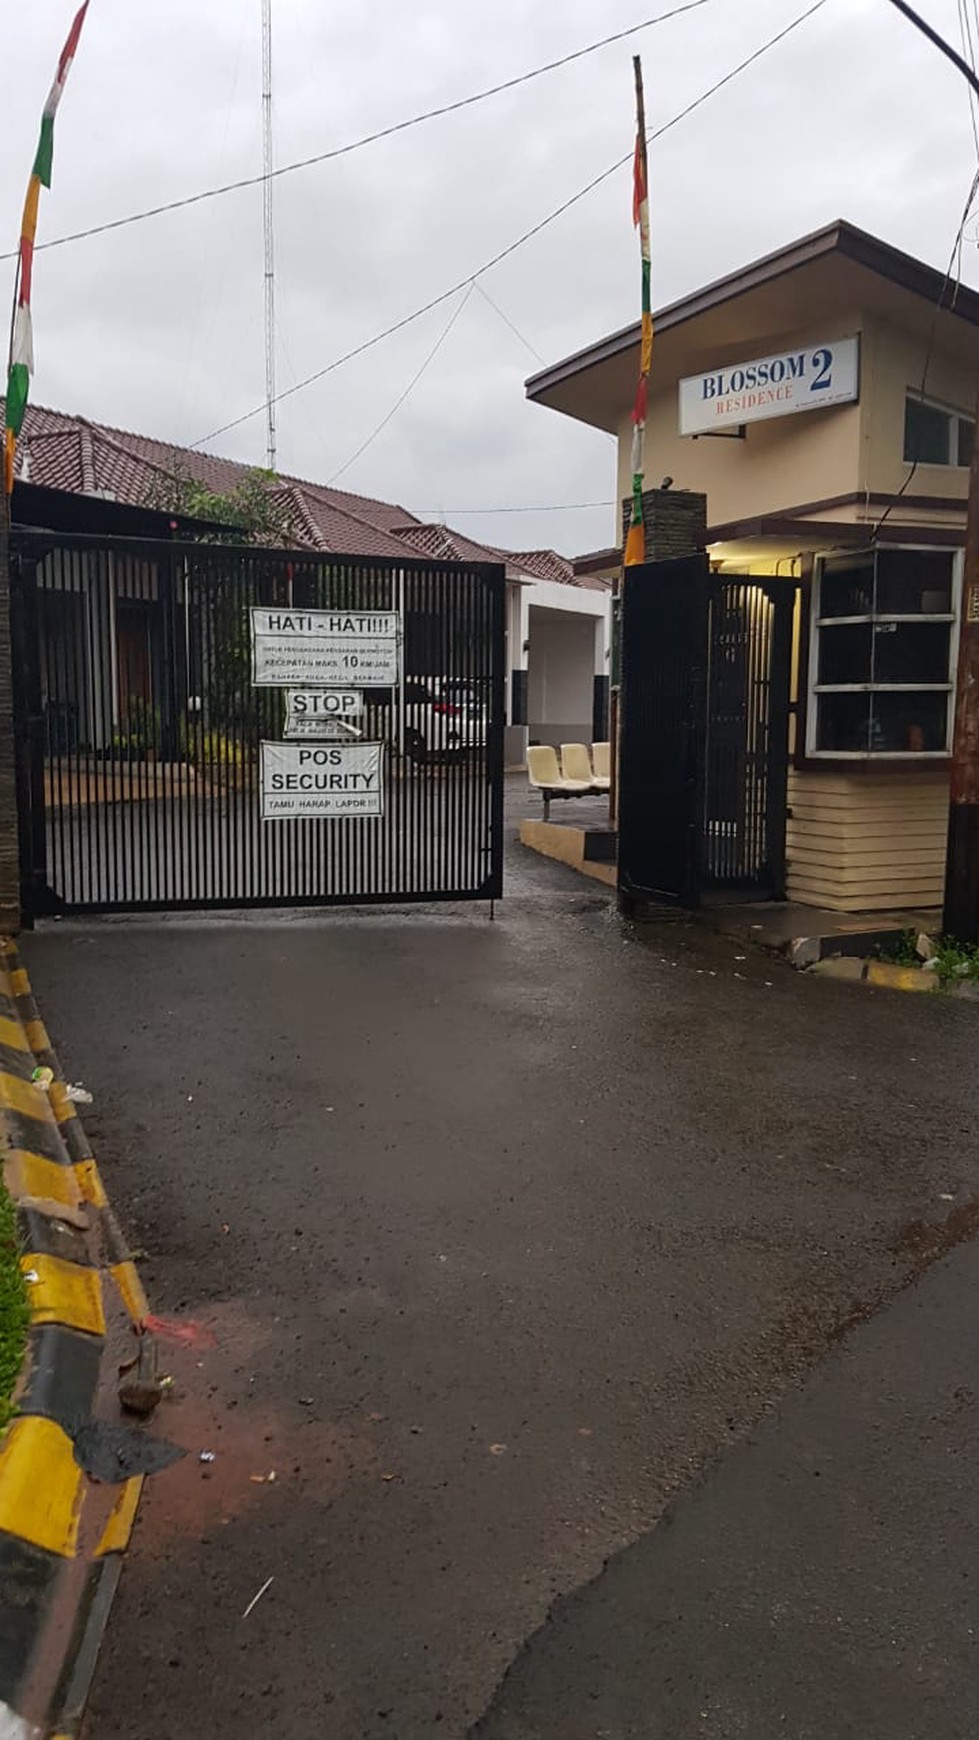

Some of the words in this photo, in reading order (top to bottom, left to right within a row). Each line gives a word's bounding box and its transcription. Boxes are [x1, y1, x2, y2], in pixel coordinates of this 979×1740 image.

[702, 353, 806, 400] BLOSSOM
[809, 348, 834, 392] 2
[716, 384, 794, 415] RESIDENCE
[268, 615, 312, 632] HATI
[341, 655, 359, 668] 10
[293, 694, 355, 713] STOP
[299, 750, 342, 766] POS
[271, 773, 375, 790] SECURITY
[269, 800, 295, 809] TAMU
[299, 799, 331, 809] HARAP
[335, 799, 366, 808] LAPOR
